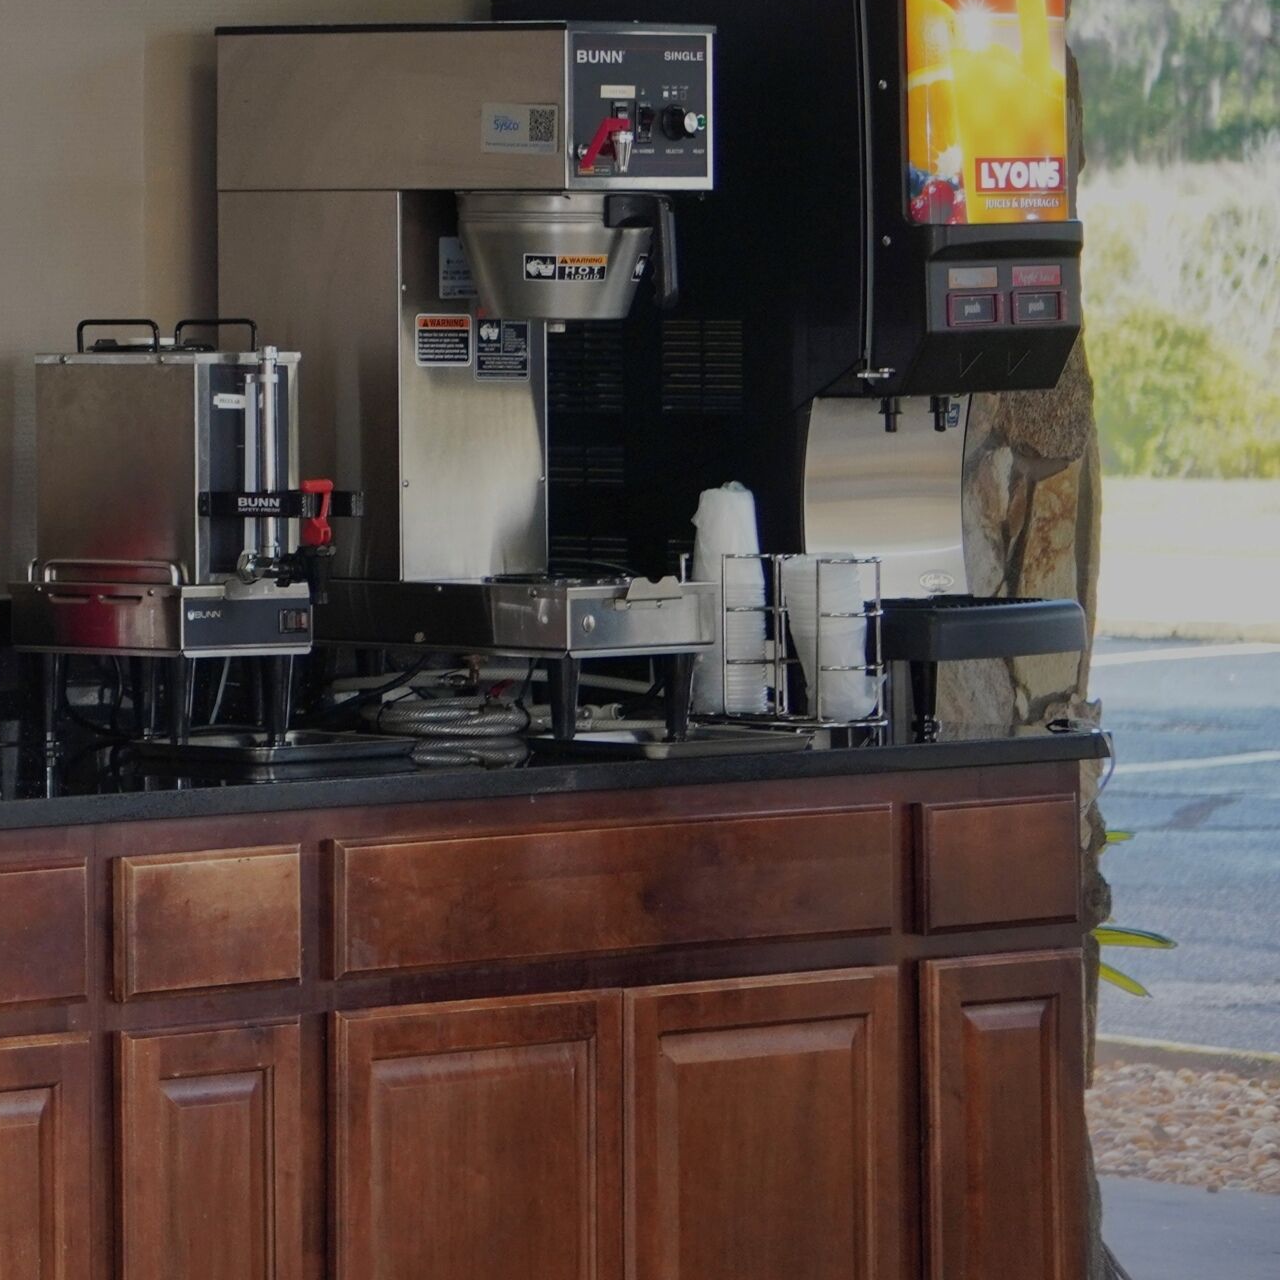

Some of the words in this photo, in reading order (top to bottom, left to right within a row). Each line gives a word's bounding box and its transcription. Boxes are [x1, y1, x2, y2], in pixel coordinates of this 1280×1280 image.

[576, 50, 623, 64] BUNN
[664, 51, 704, 61] SINGLE
[493, 118, 519, 133] Sysco
[1020, 197, 1059, 209] BEVERAGES
[569, 256, 603, 264] WARNING
[565, 266, 602, 275] HOT
[429, 318, 465, 327] WARNING
[237, 497, 280, 507] BUNN
[194, 610, 221, 619] BUNN
